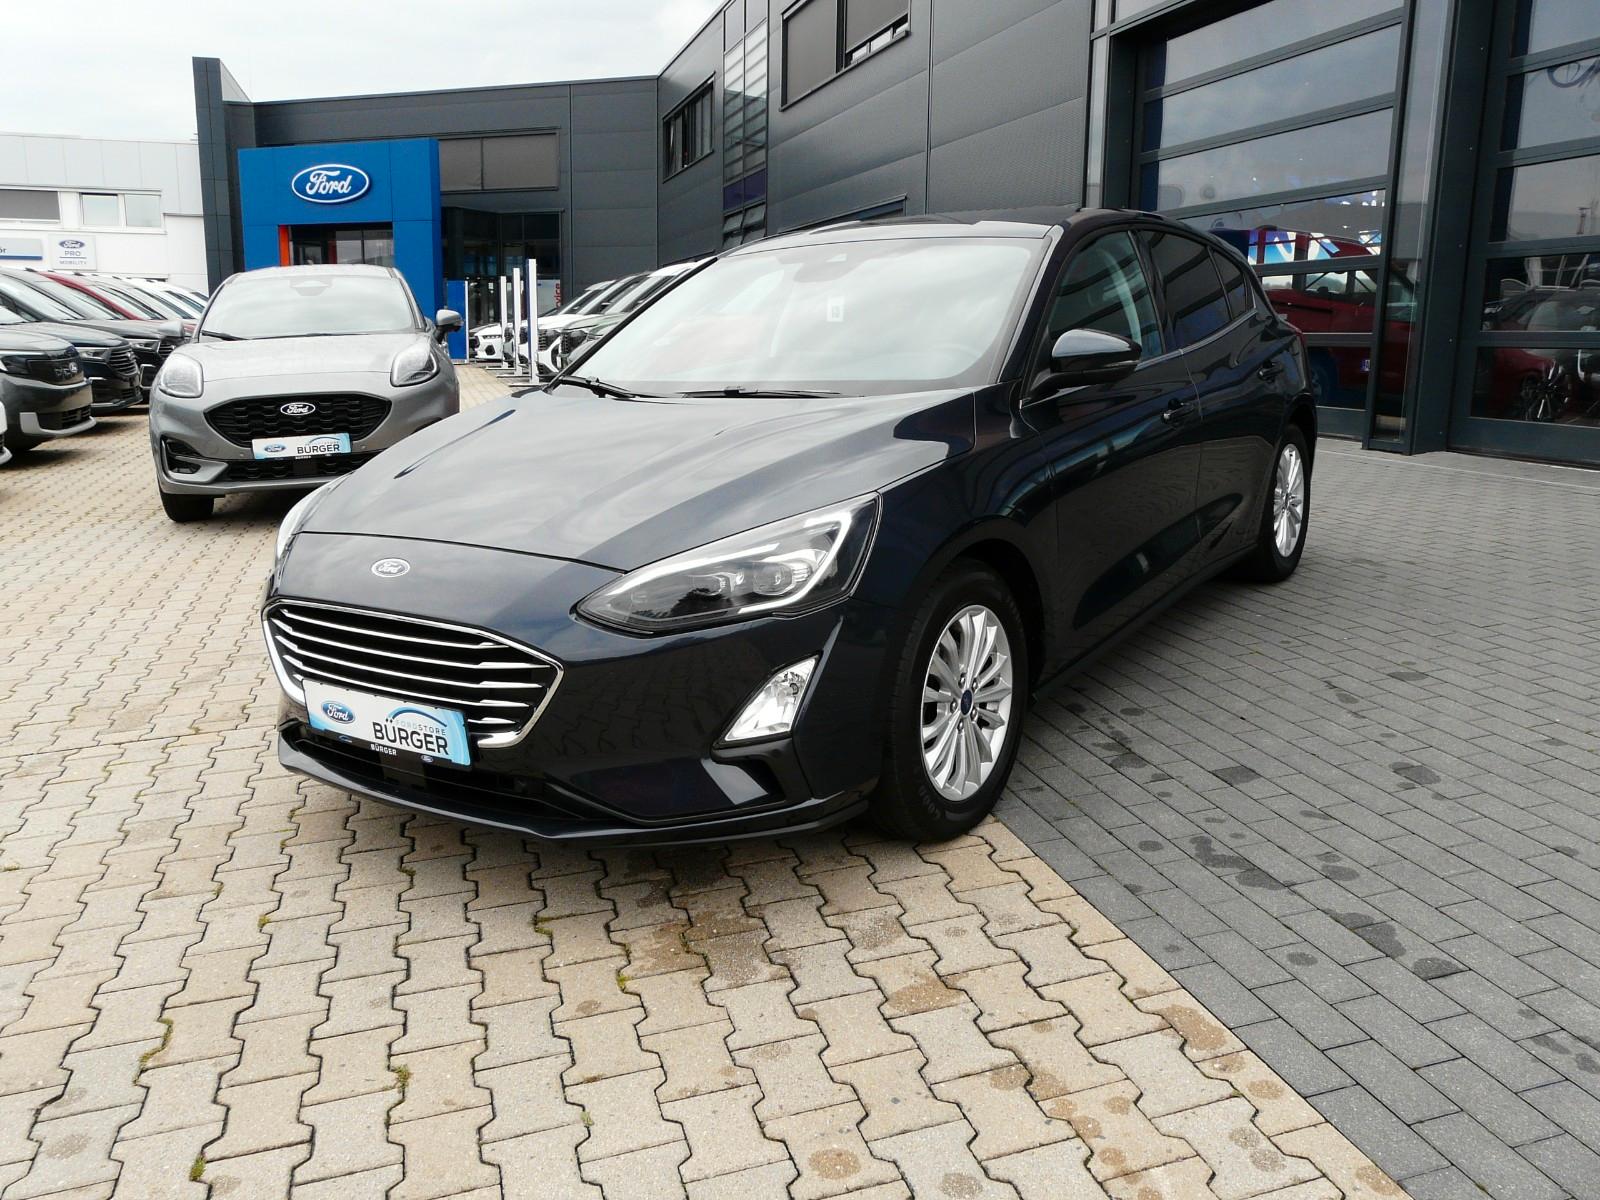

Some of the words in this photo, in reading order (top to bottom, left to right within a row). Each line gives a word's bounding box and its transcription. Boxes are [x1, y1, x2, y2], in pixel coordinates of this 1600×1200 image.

[306, 170, 352, 195] Ford
[286, 404, 309, 414] Ford
[379, 561, 402, 573] Ford
[327, 703, 350, 721] Ford
[372, 717, 449, 755] BÜRGER
[395, 719, 446, 736] FORDSTORE
[370, 743, 397, 756] BÜRGER
